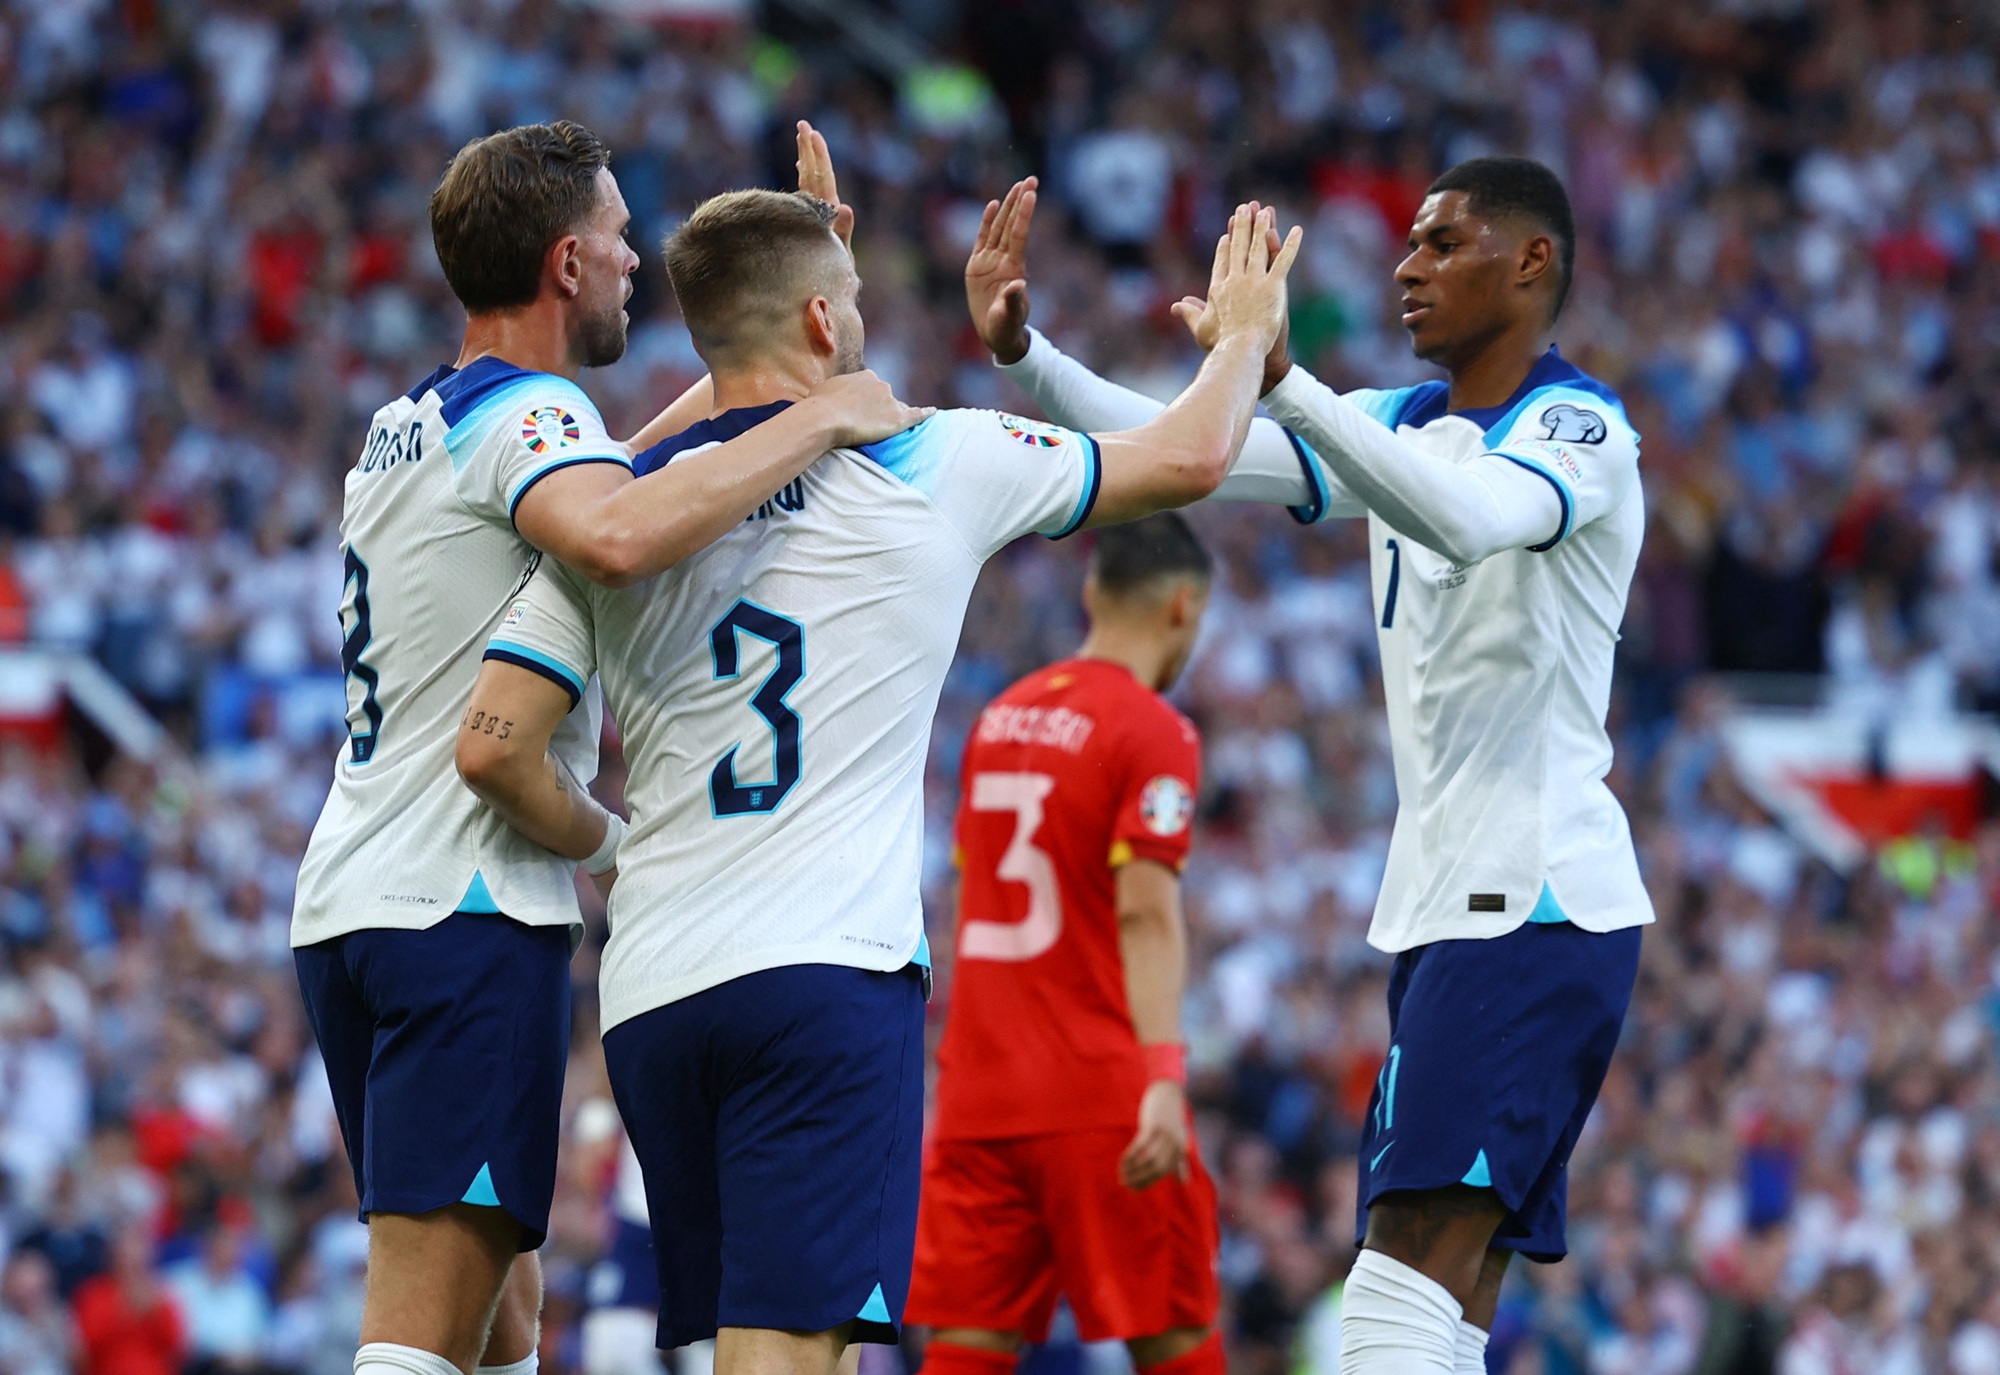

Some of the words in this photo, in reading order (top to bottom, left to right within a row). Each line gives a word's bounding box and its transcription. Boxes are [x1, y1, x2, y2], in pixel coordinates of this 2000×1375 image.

[338, 542, 383, 766] 8
[463, 706, 513, 740] 1995
[708, 597, 807, 819] 3
[960, 772, 1064, 962] 3
